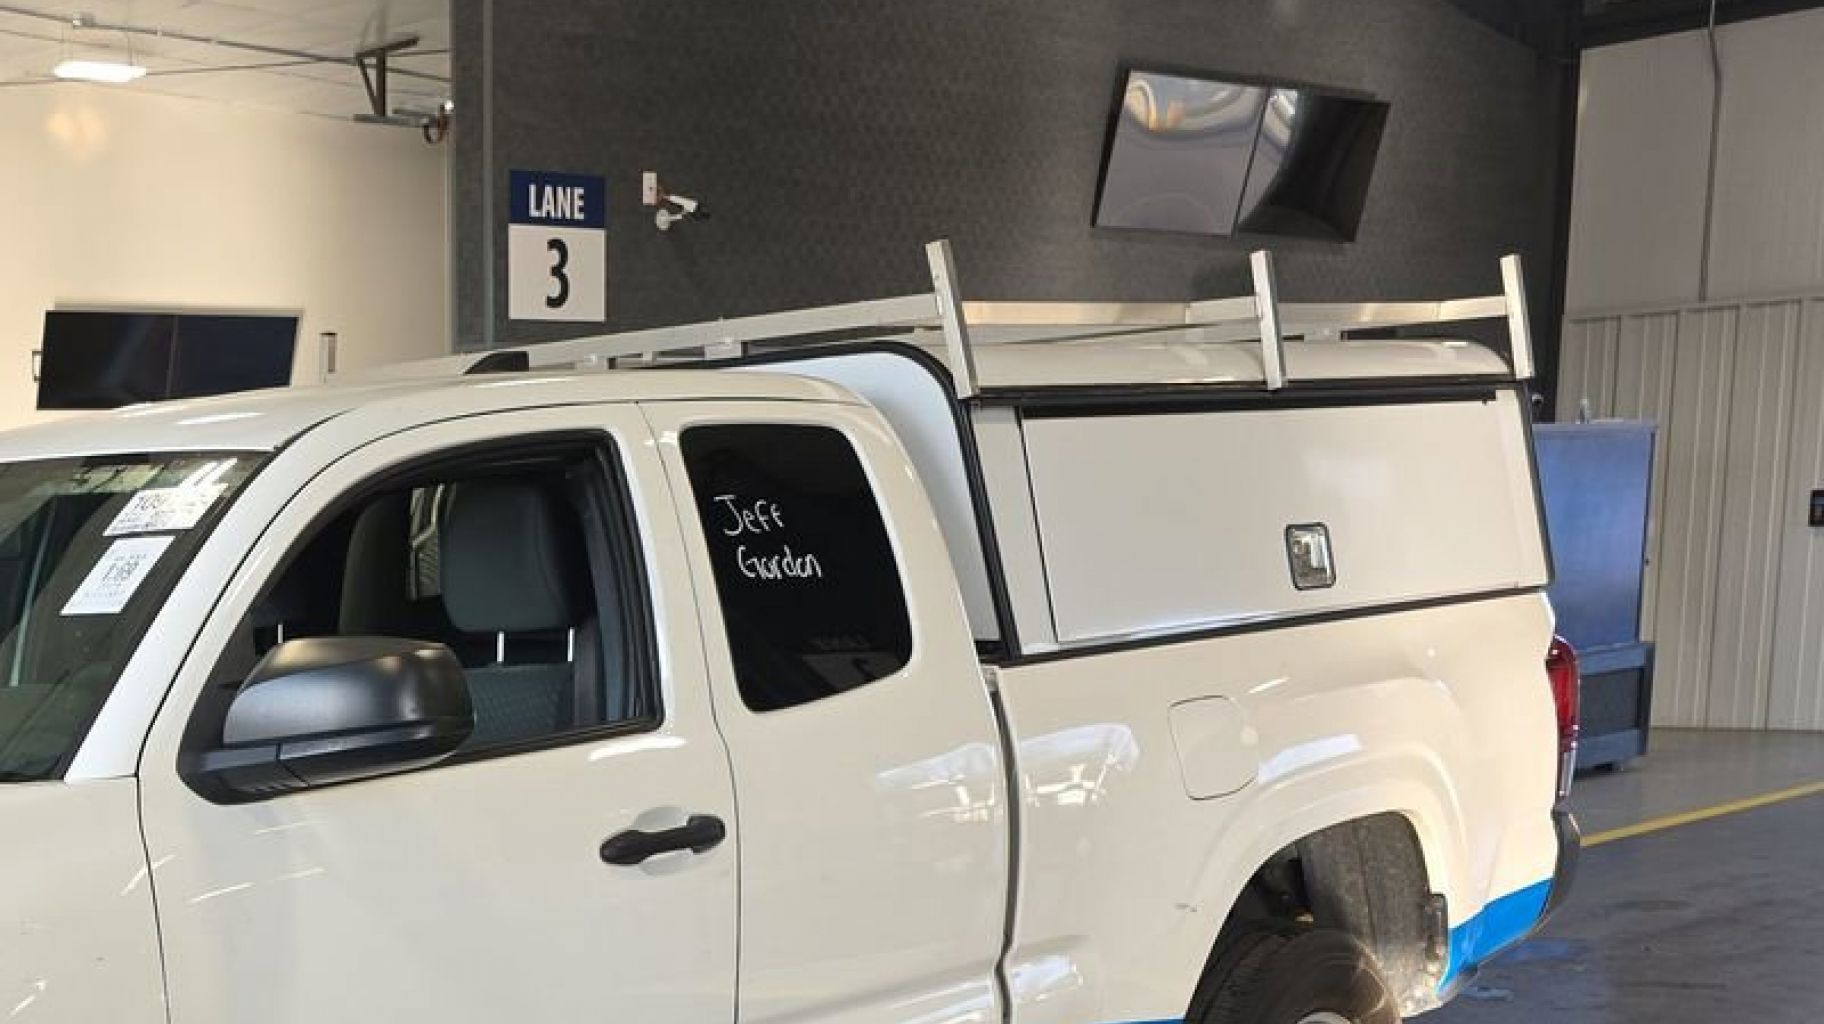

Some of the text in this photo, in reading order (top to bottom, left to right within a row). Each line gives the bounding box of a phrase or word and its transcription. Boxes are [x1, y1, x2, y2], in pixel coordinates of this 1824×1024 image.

[528, 184, 585, 220] LANE
[545, 238, 569, 308] 3
[714, 494, 784, 536] Jeff
